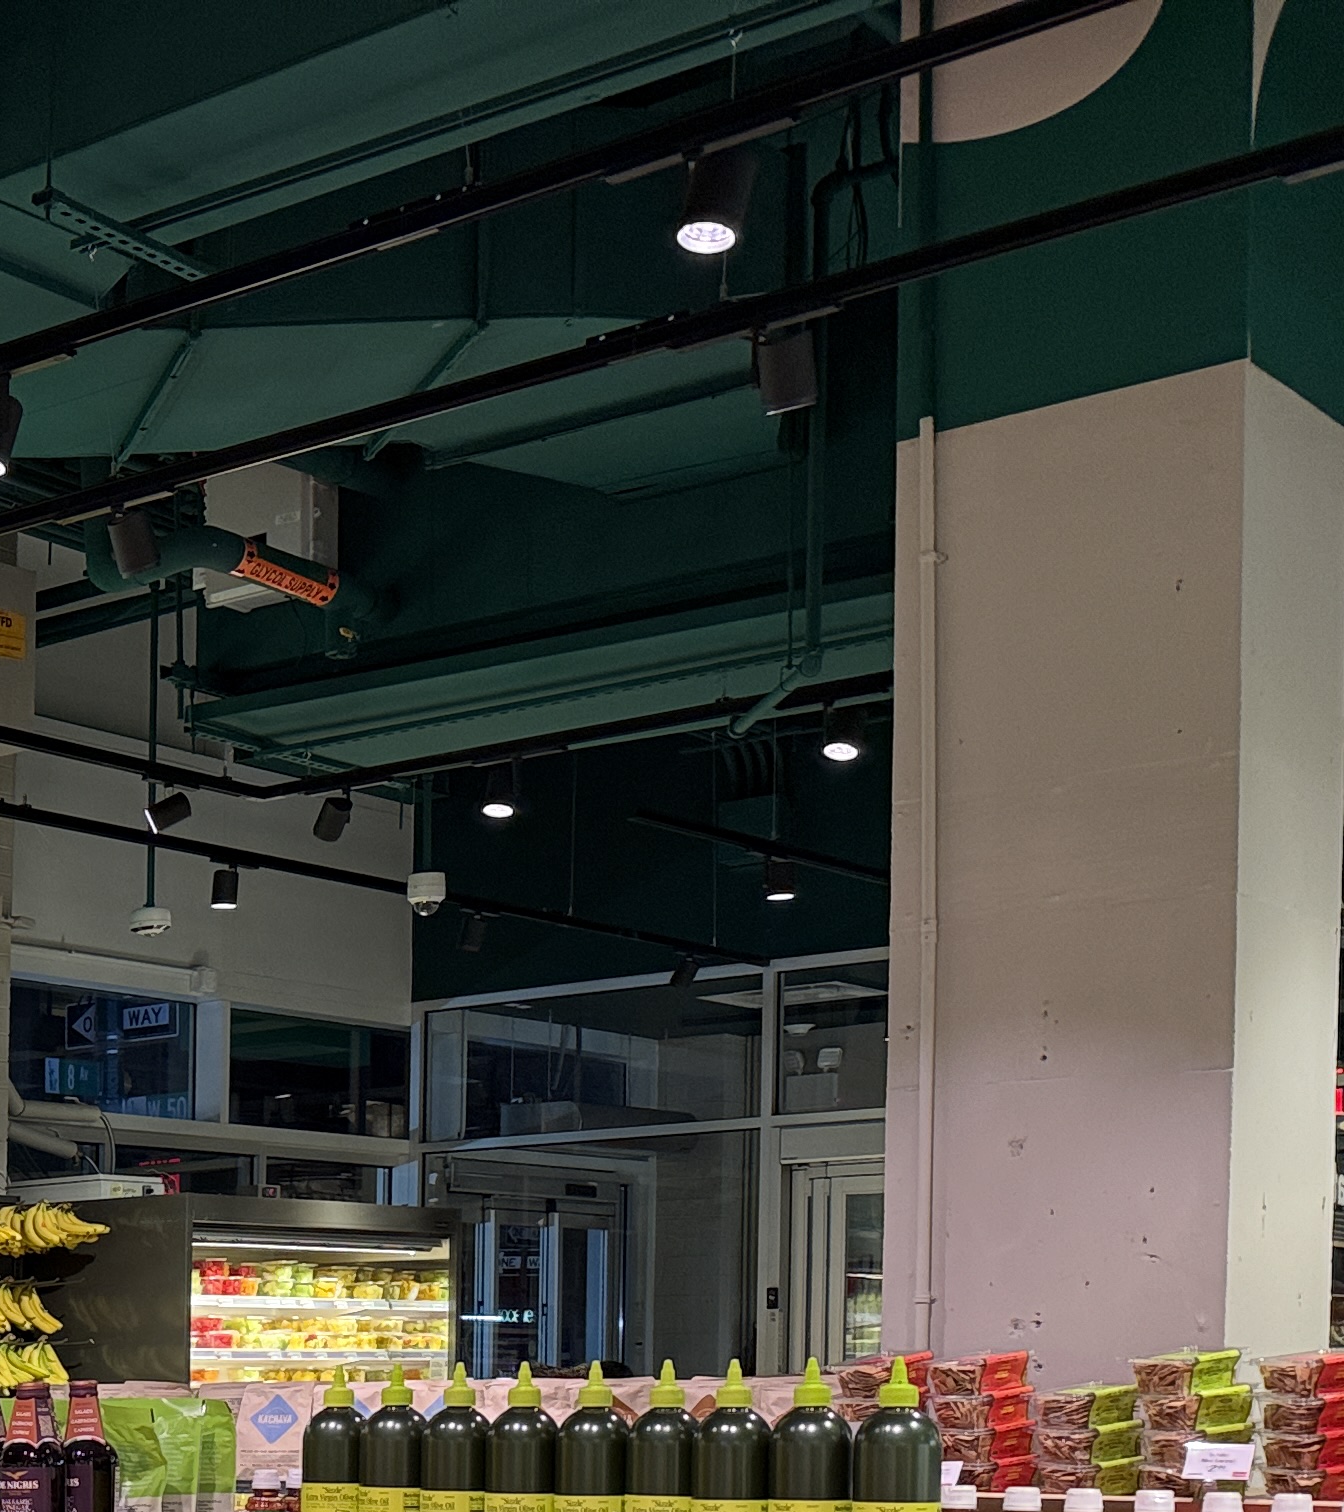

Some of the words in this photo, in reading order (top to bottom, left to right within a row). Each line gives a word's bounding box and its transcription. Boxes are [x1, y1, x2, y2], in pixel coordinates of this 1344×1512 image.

[250, 563, 283, 587] GLYCOL
[284, 576, 323, 599] SUPPLY
[128, 1006, 163, 1027] WAY
[67, 1063, 75, 1089] 8
[146, 1099, 161, 1116] W
[167, 1096, 187, 1118] 50
[7, 1480, 39, 1489] NIGRIS
